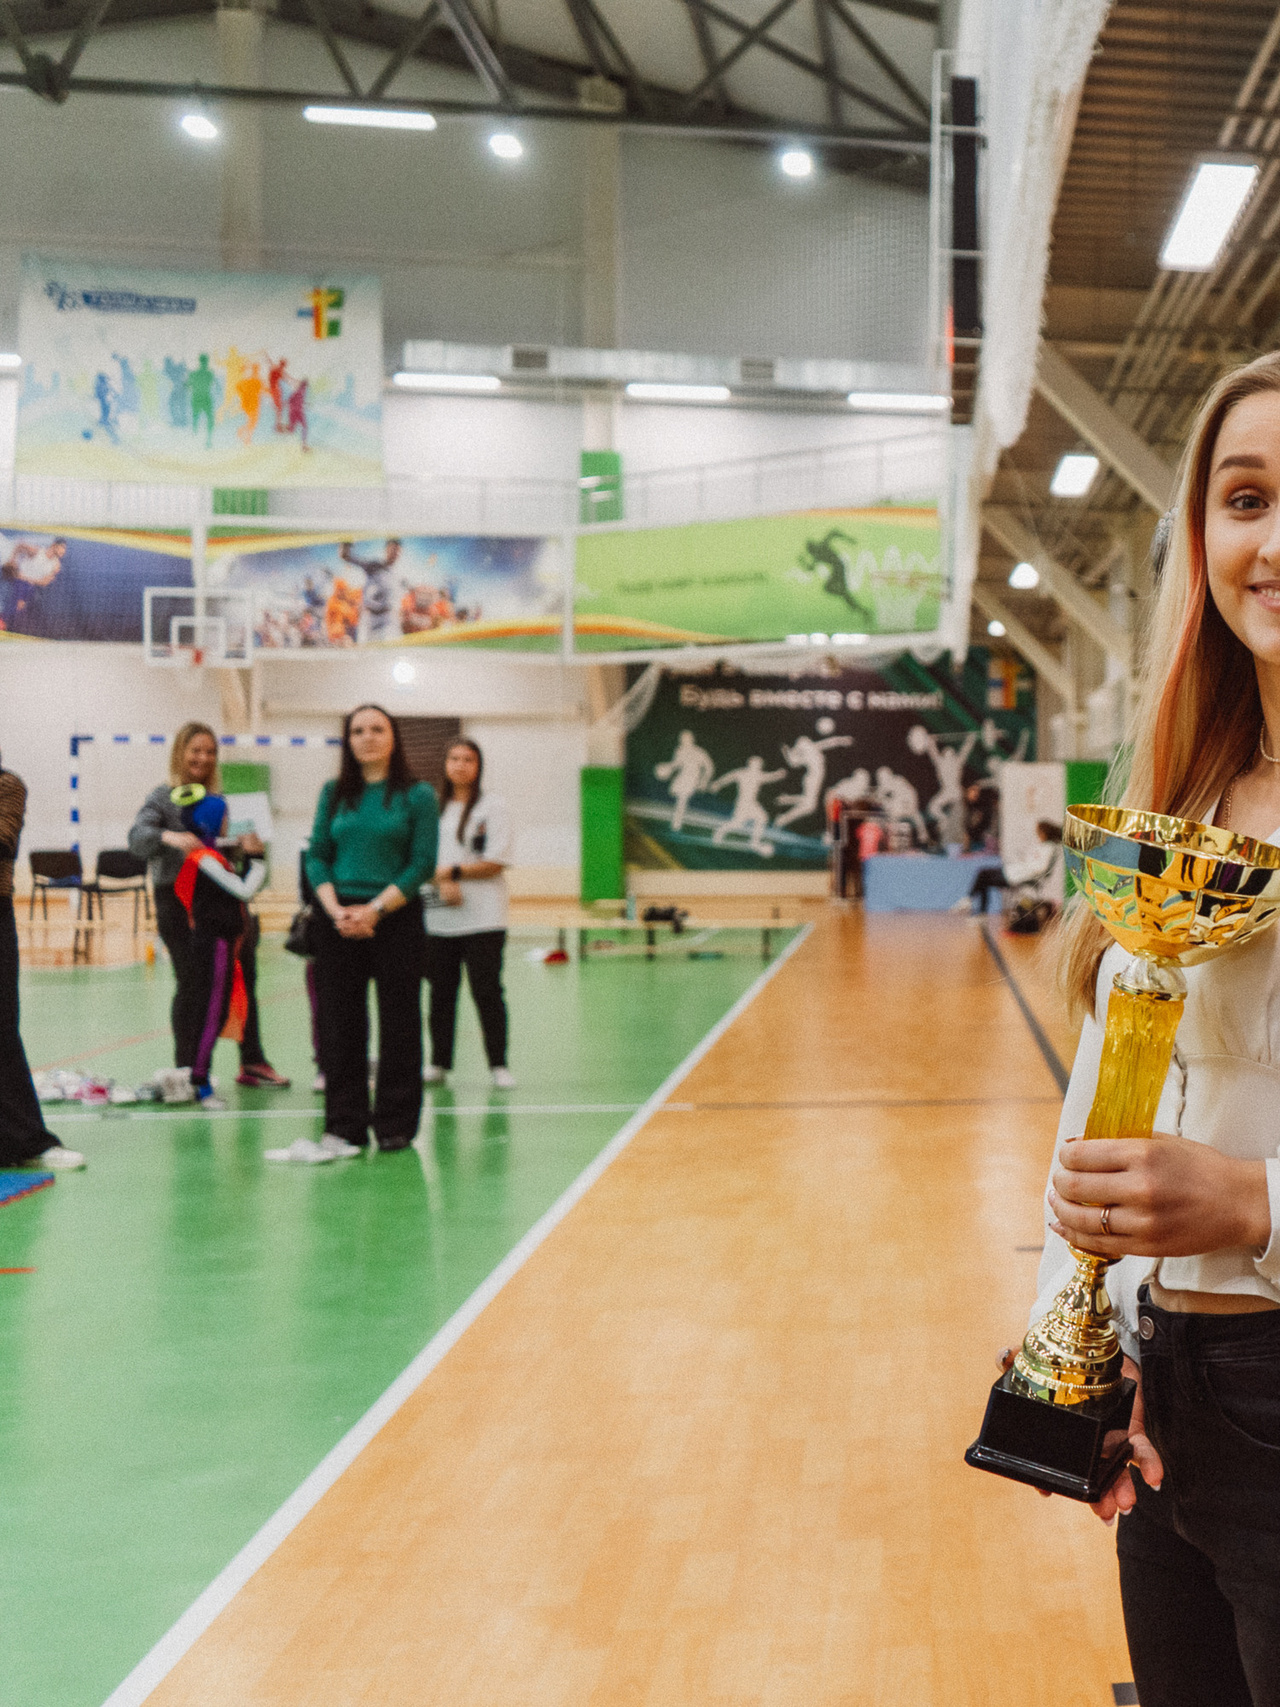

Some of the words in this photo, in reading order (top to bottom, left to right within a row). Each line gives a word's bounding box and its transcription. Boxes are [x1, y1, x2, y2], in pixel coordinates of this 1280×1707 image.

[679, 684, 745, 711] Будь
[748, 688, 844, 710] вместе
[846, 689, 865, 710] с
[867, 689, 944, 711] нами!
